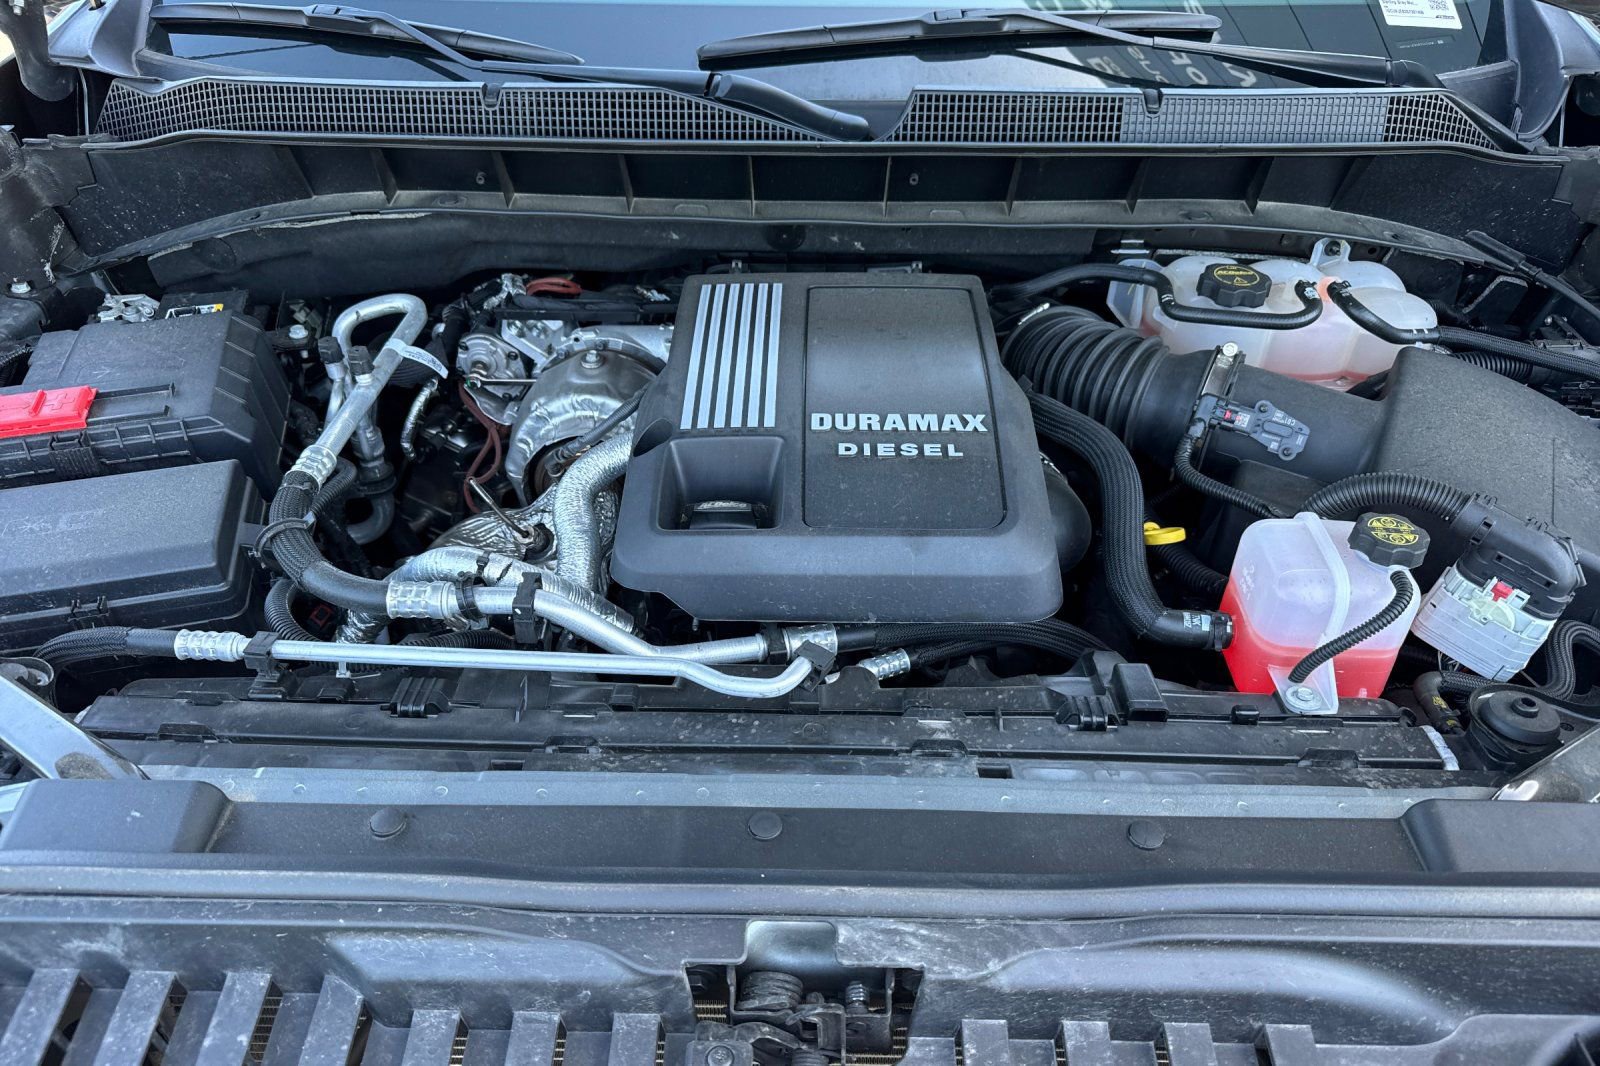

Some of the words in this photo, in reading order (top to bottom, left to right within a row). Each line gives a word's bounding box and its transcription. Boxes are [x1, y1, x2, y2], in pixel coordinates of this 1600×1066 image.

[811, 413, 988, 432] DURAMAX
[838, 443, 964, 457] DIESEL
[698, 501, 747, 510] ACDelco
